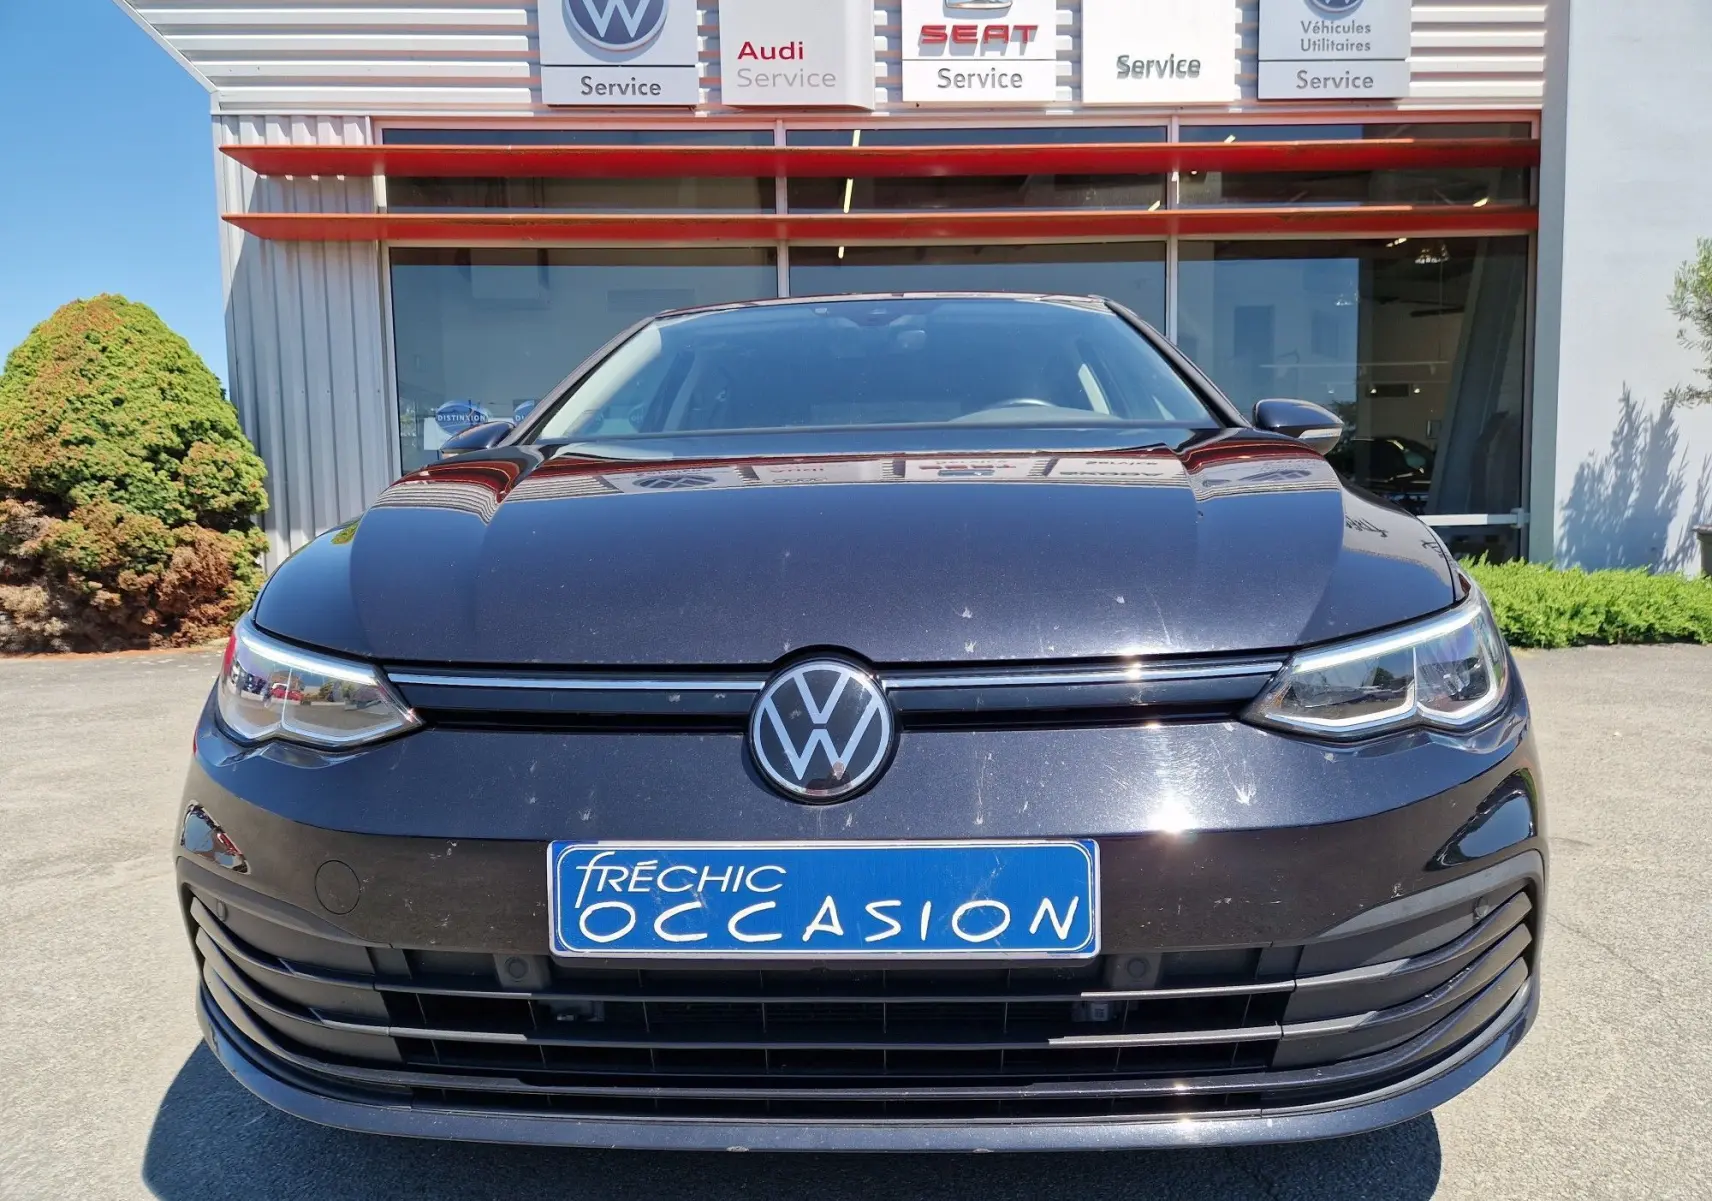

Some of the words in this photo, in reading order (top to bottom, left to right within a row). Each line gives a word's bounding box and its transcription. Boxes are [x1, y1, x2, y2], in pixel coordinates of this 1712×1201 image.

[920, 25, 1039, 44] SEAT
[1300, 21, 1371, 34] Véhicules
[737, 41, 804, 60] Audi
[1300, 38, 1371, 52] Utilitaires
[1117, 54, 1201, 79] Service
[580, 75, 662, 96] Service
[737, 68, 837, 88] Service
[938, 67, 1023, 89] Service
[1296, 69, 1374, 90] Service
[578, 895, 1080, 943] OCCASION
